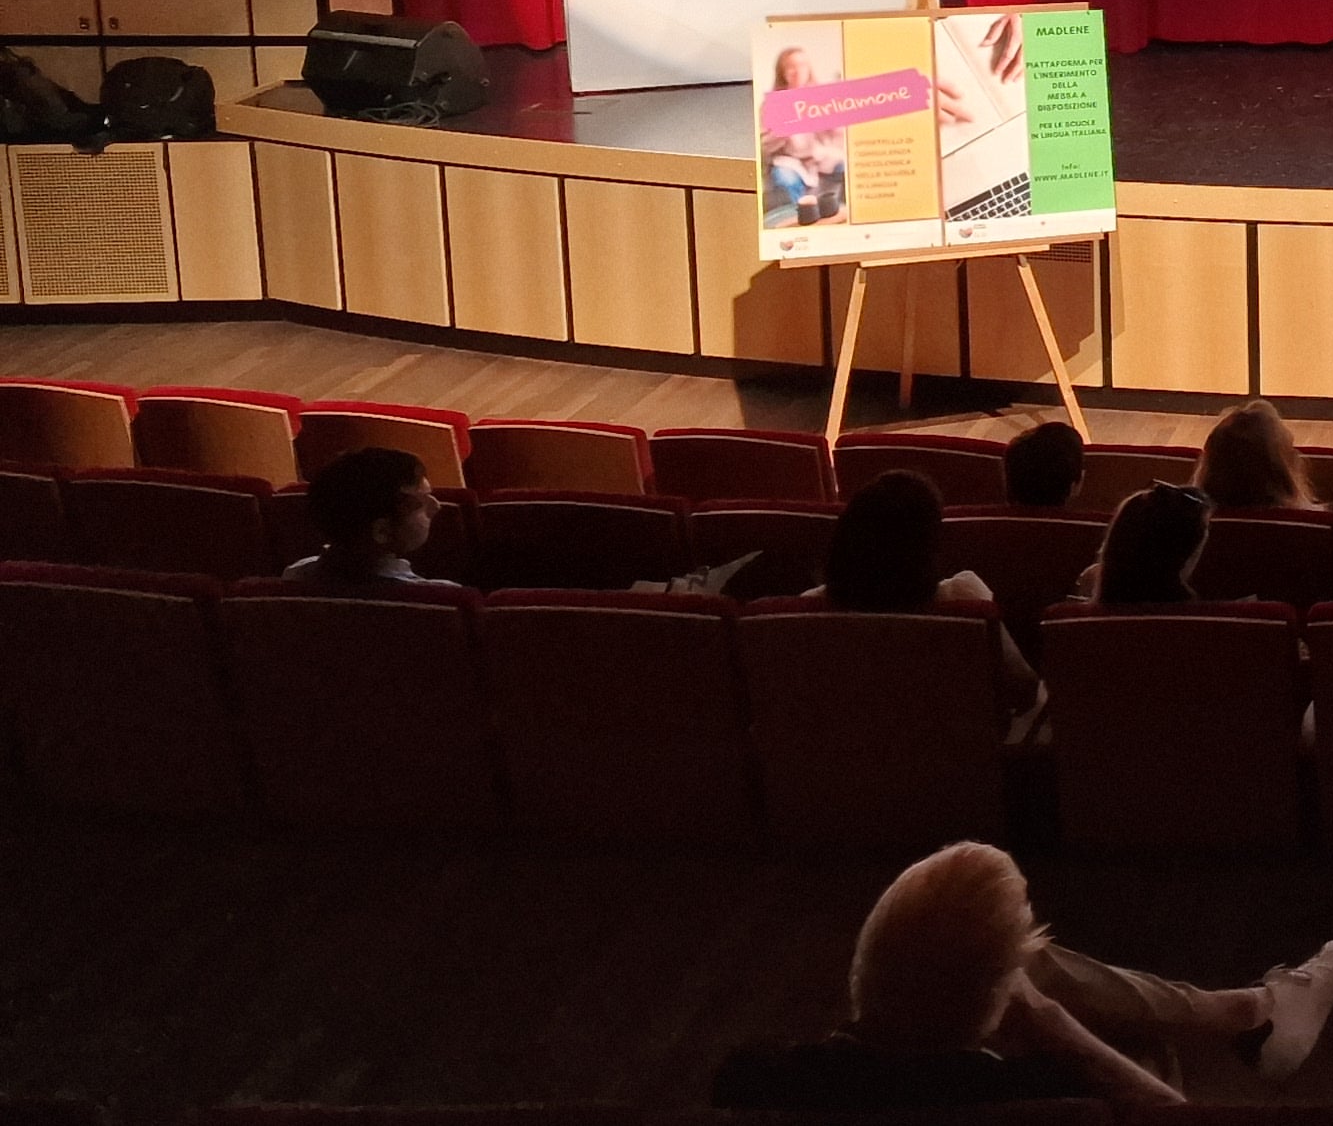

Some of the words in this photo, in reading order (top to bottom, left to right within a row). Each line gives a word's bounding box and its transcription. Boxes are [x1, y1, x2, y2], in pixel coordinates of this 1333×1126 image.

[1036, 25, 1091, 36] MADLENE
[1089, 58, 1104, 66] PER
[1051, 81, 1078, 89] DELLA
[1037, 101, 1097, 112] DISPOSIZIONE
[1041, 131, 1069, 139] LINGUA
[1072, 128, 1106, 137] ITALIANA
